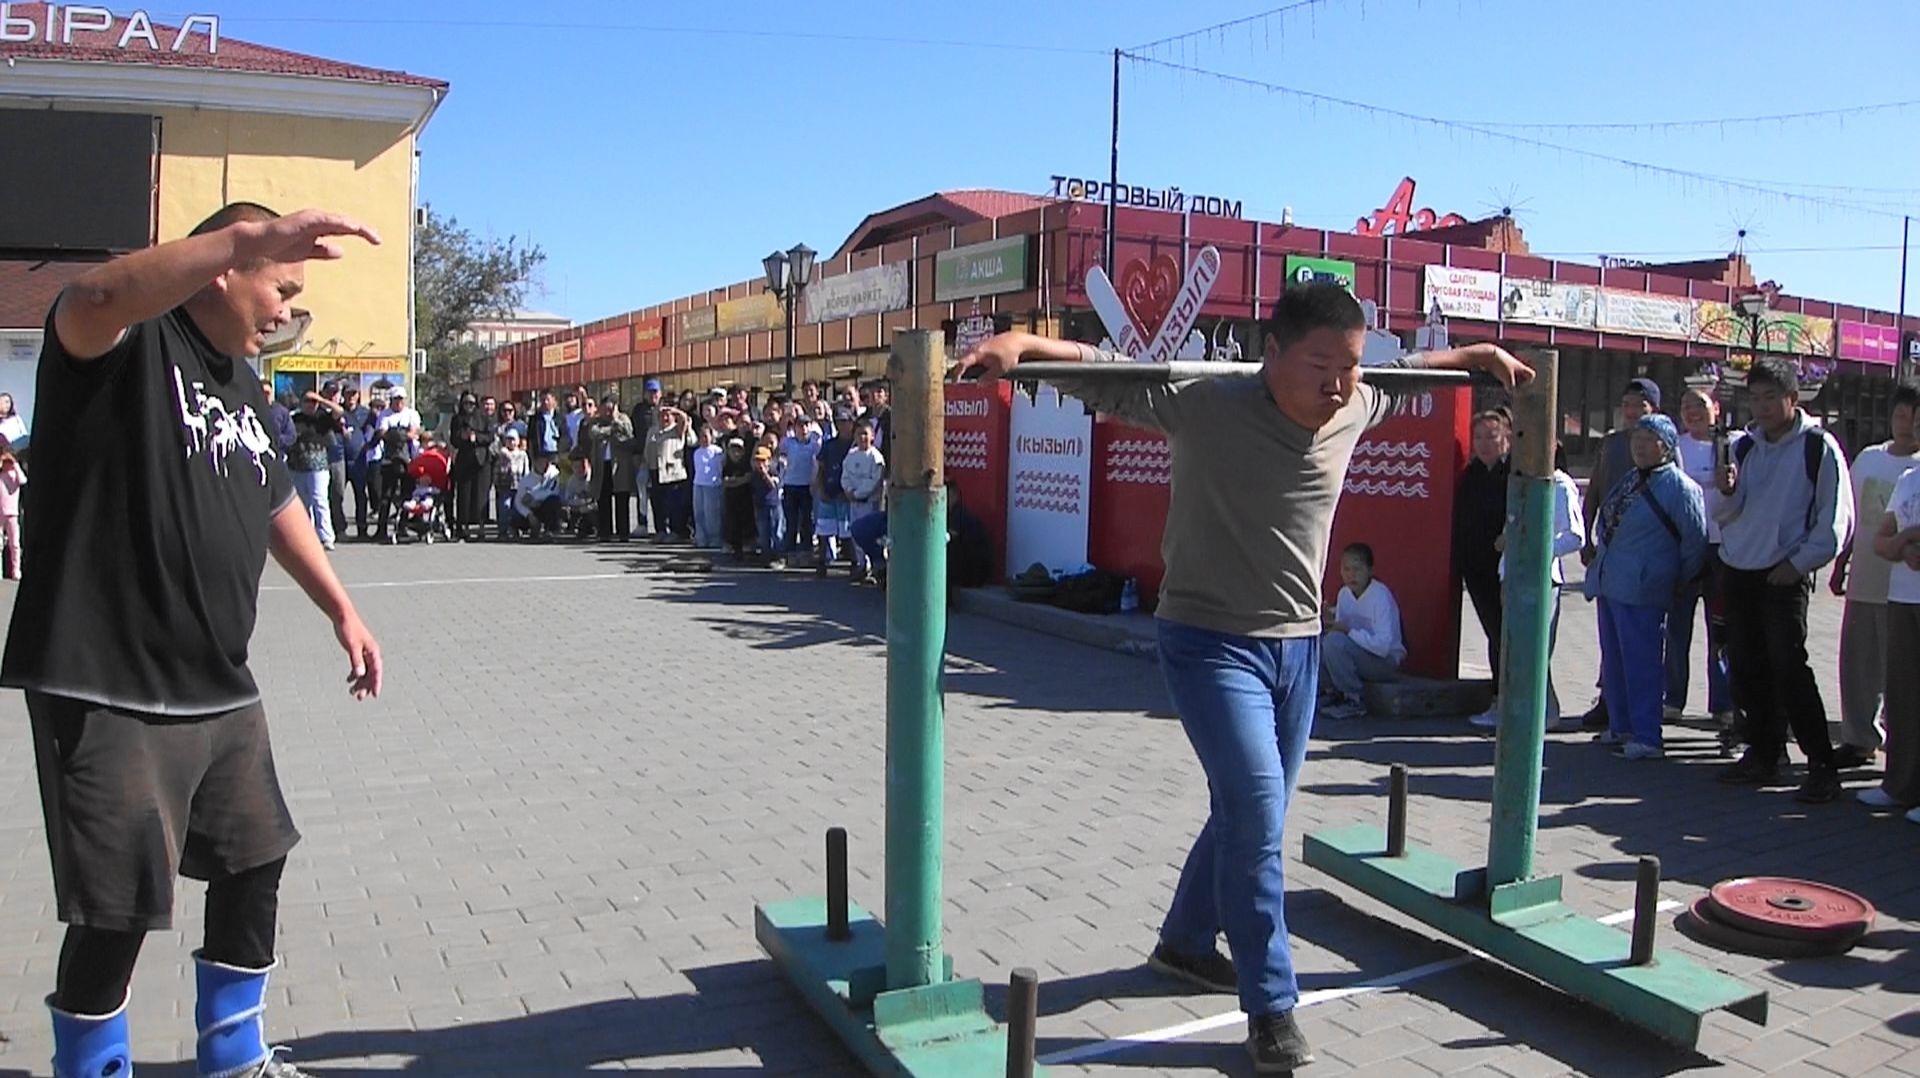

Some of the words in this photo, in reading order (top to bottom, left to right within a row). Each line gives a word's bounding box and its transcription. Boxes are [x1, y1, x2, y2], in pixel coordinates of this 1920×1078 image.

[1051, 175, 1184, 211] ТОРГОВЫЙ
[1190, 195, 1242, 220] ДОМ
[970, 256, 1003, 279] АКША
[1151, 266, 1210, 362] ЫЗЫЛ
[945, 400, 982, 416] ЫЗЫЛ
